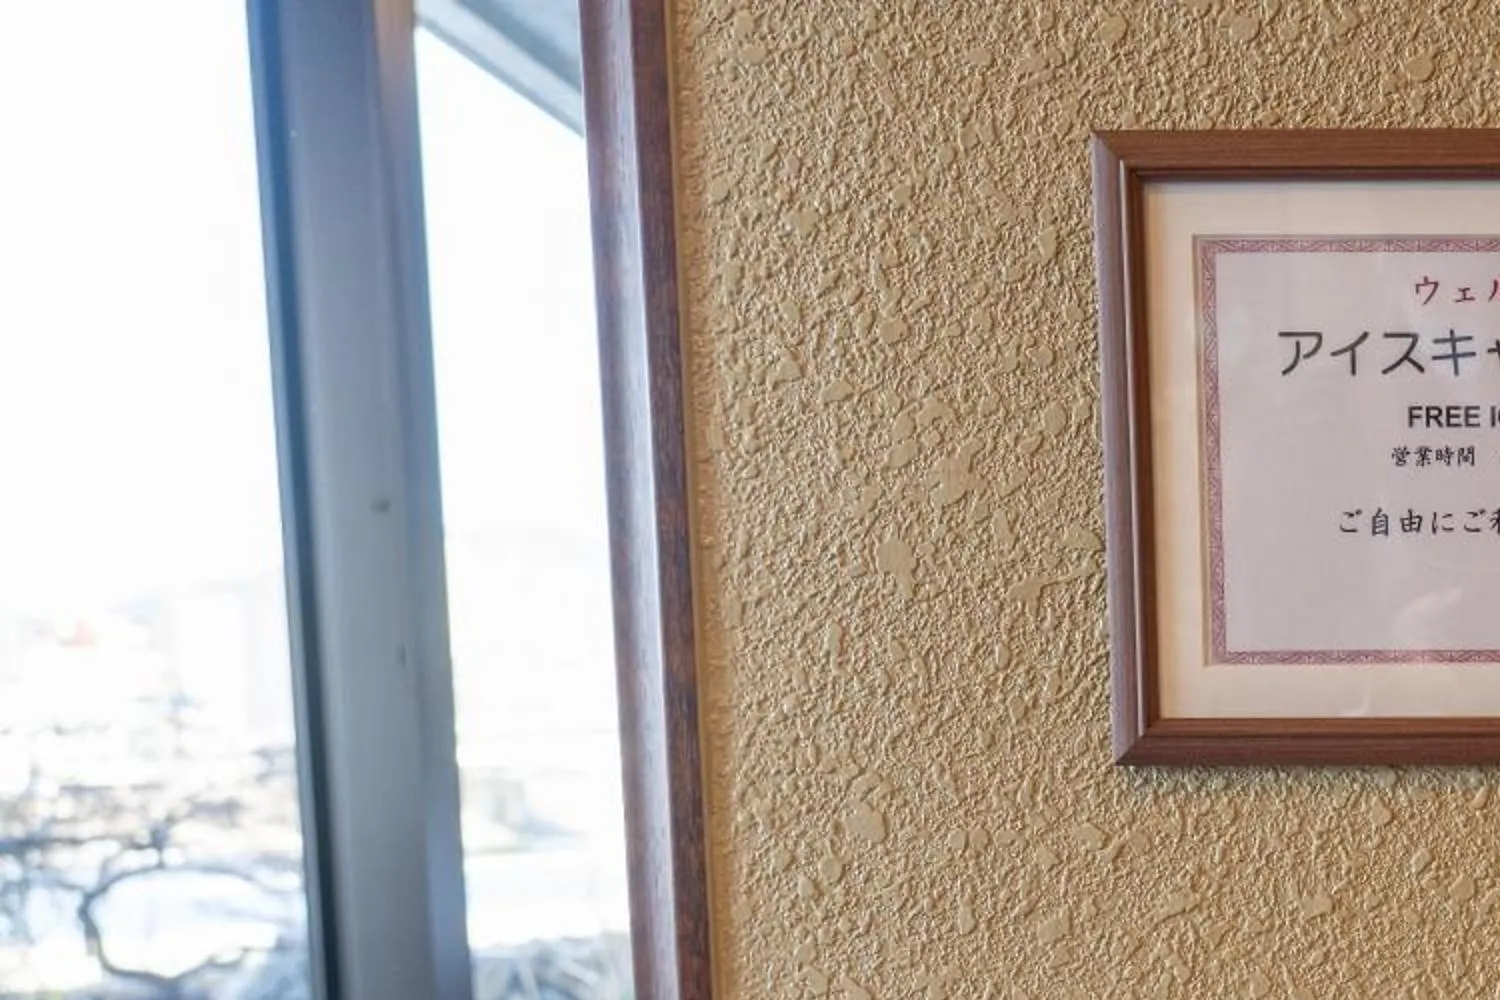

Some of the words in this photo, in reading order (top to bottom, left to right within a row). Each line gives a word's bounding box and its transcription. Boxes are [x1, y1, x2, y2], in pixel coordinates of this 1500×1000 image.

[1407, 404, 1481, 429] FREE
[1391, 445, 1476, 468] 営業時間
